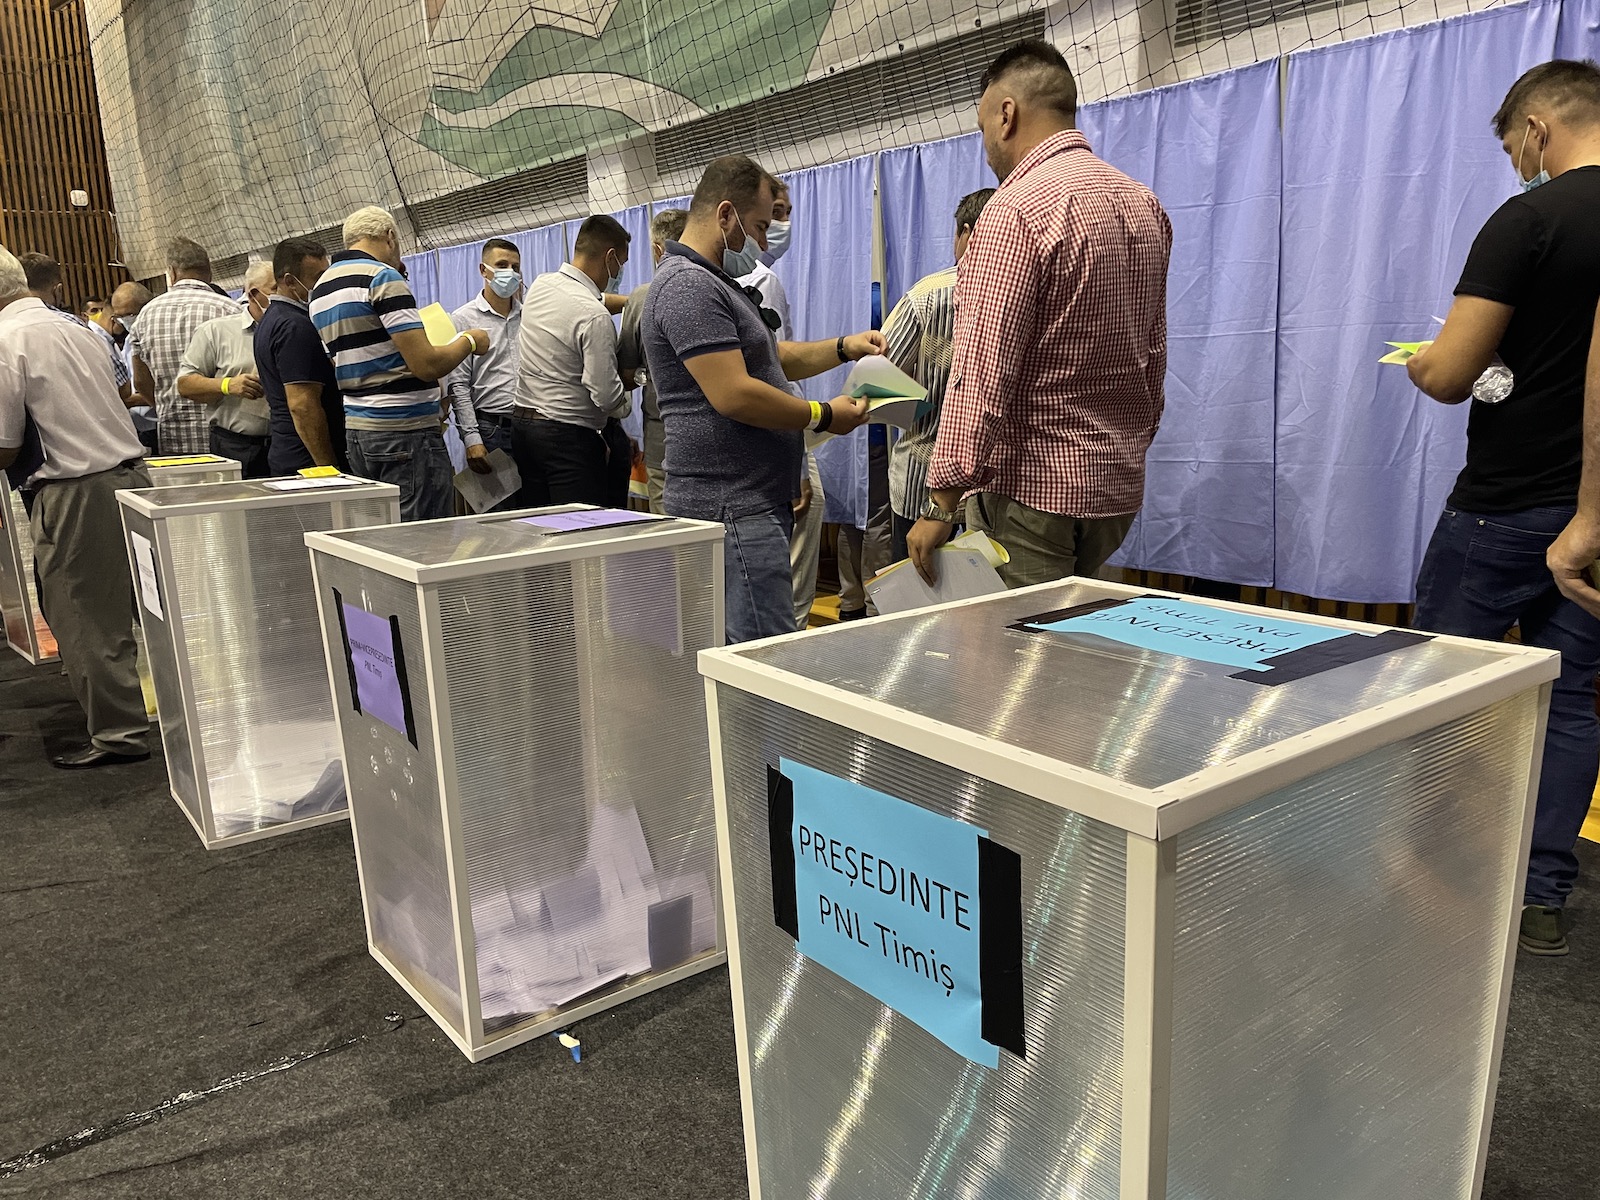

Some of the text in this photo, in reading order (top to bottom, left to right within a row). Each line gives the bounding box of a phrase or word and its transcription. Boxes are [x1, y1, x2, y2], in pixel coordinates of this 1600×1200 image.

[1232, 622, 1302, 638] PNL
[799, 824, 971, 931] PREȘEDINTE
[819, 894, 955, 997] PNL Timiș
